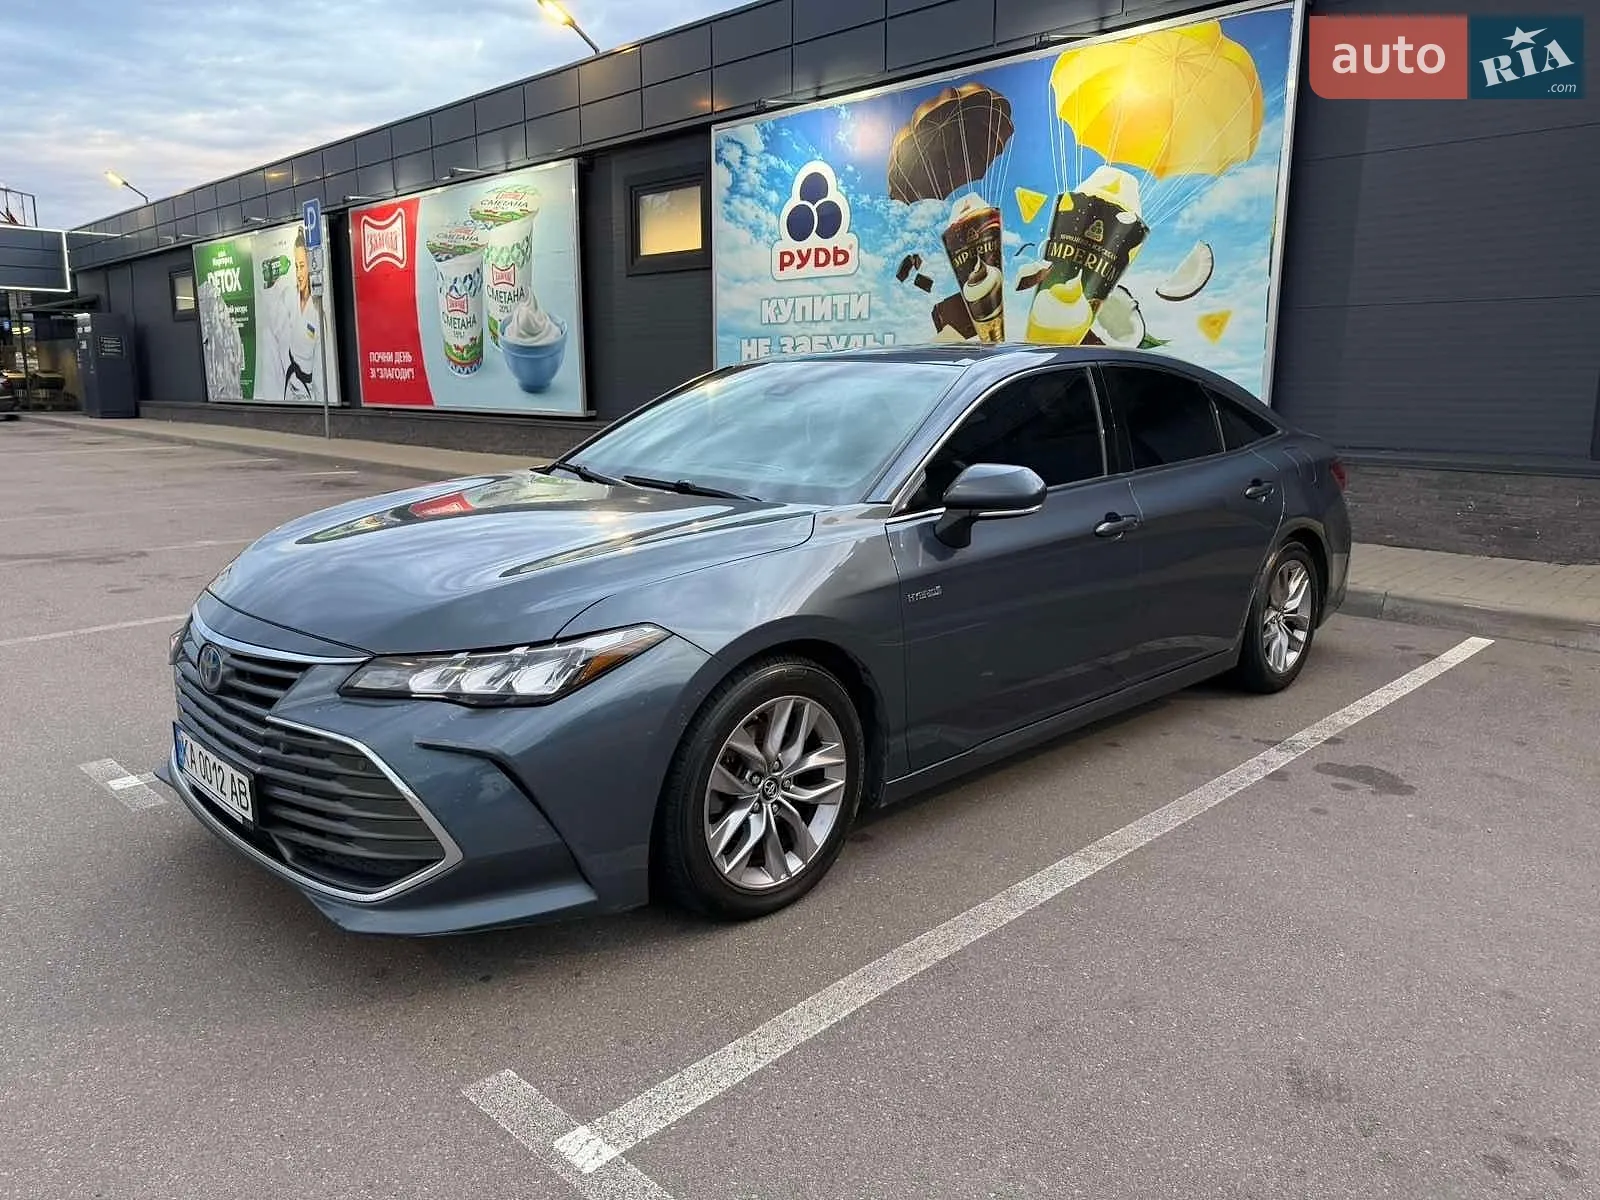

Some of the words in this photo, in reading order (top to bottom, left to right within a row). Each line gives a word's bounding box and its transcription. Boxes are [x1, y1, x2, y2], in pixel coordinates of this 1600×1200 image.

[307, 206, 316, 243] P
[779, 246, 850, 272] РУДЬ
[207, 266, 242, 297] DETOX
[487, 285, 525, 304] СМЕТАНА
[441, 311, 477, 329] СМЕТАНА
[761, 292, 871, 325] КУПИТИ
[394, 351, 413, 365] ДЕНЬ
[741, 336, 772, 361] НЕ
[198, 749, 227, 797] 0012
[231, 773, 249, 812] AB
